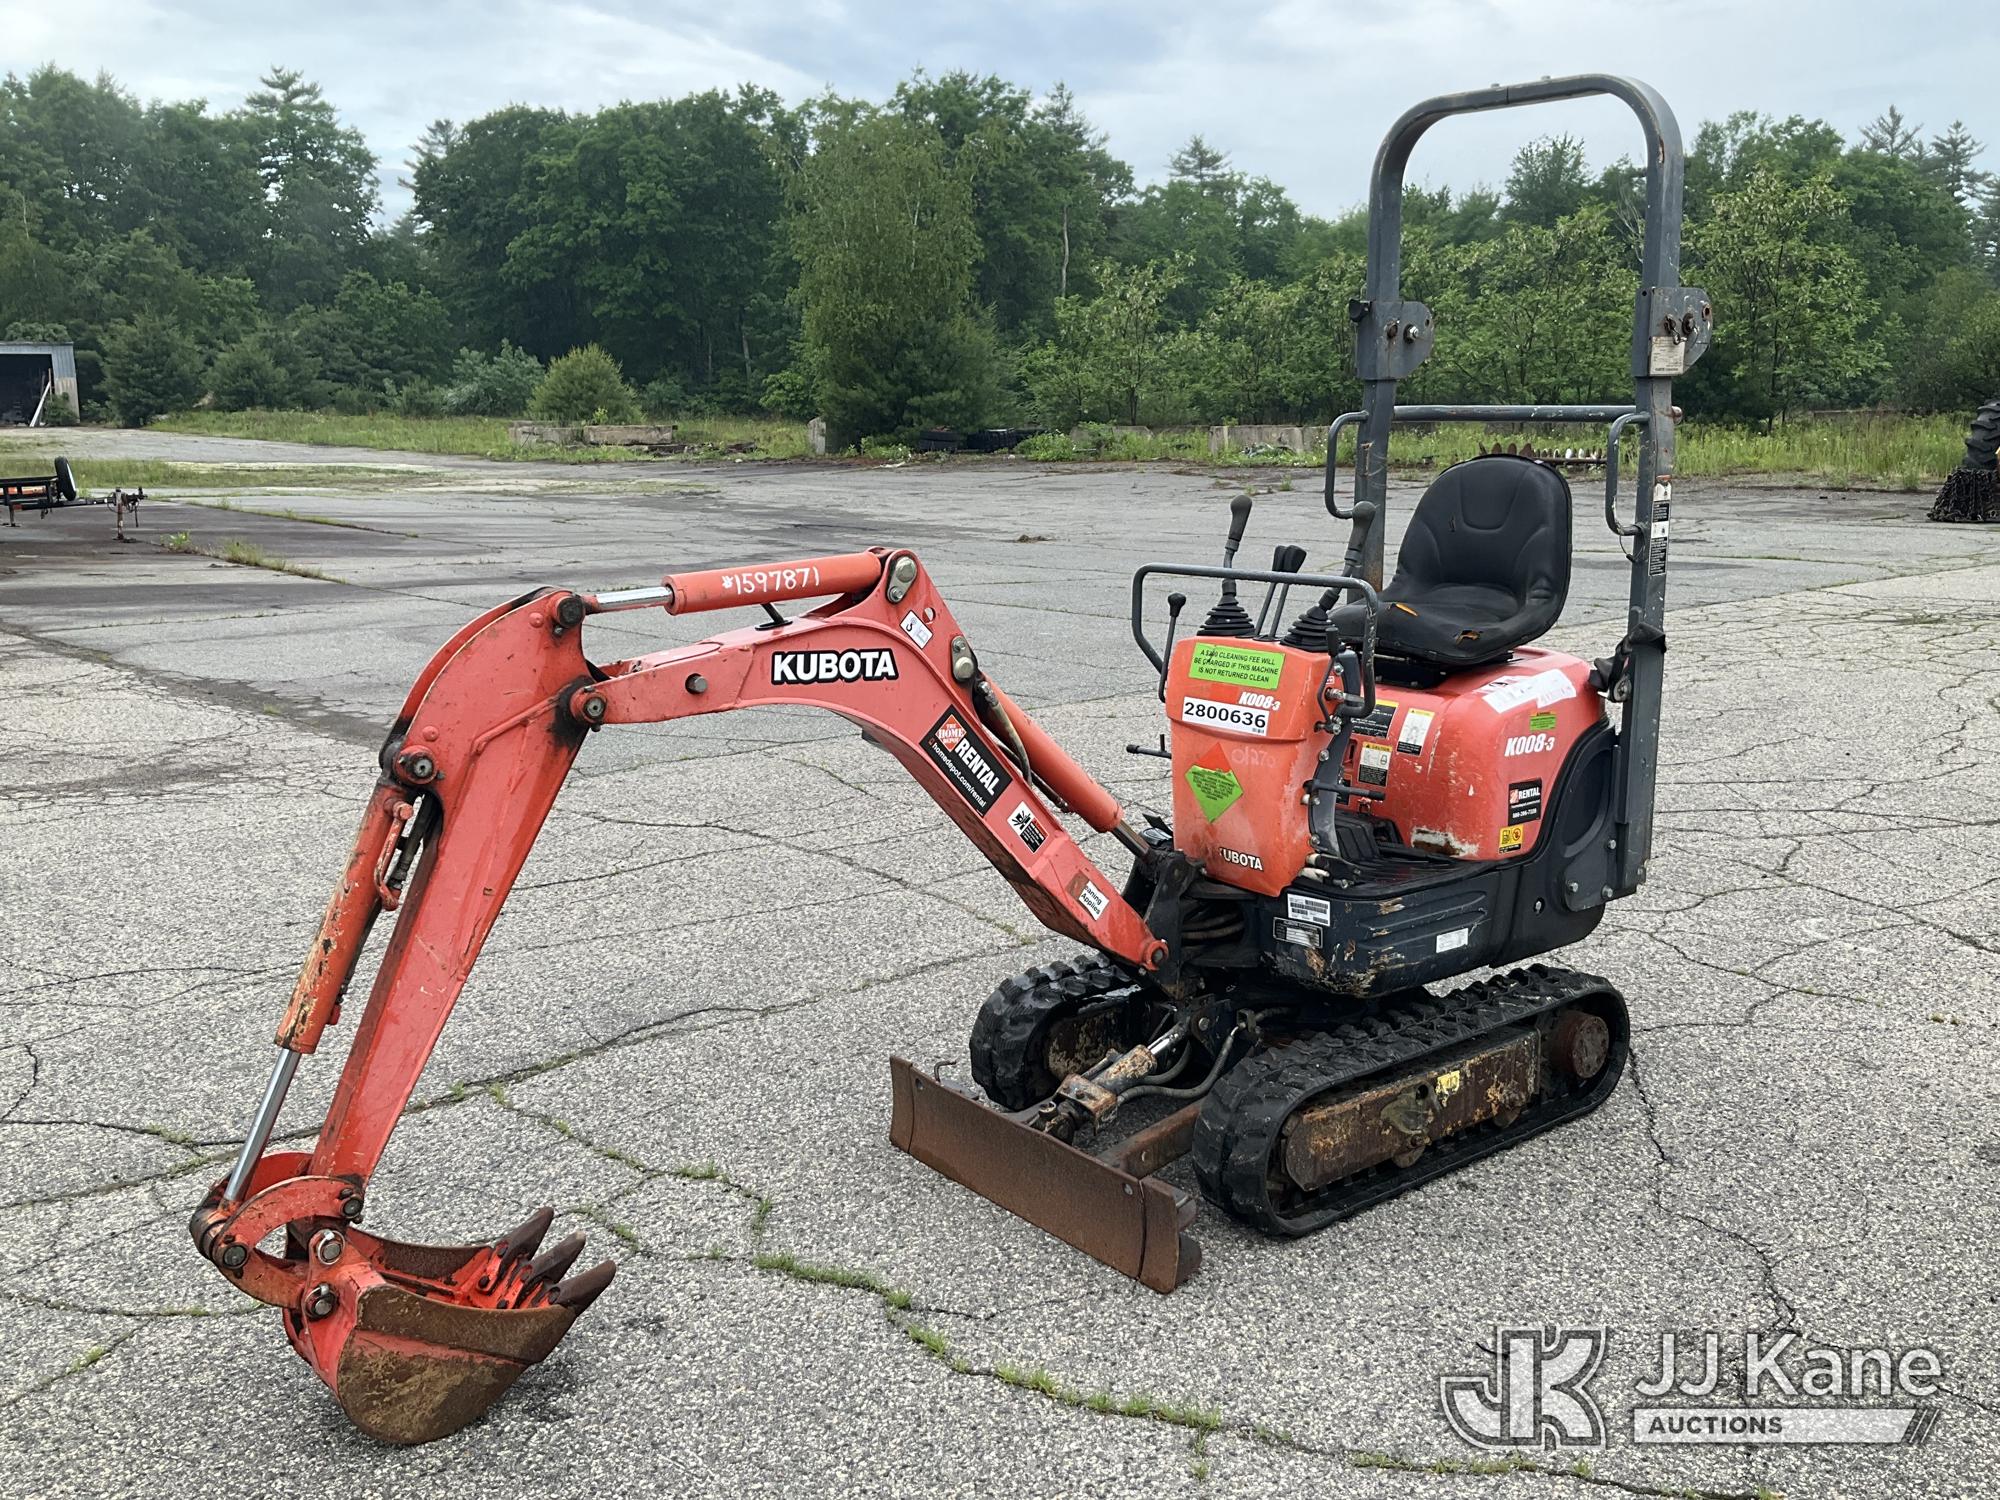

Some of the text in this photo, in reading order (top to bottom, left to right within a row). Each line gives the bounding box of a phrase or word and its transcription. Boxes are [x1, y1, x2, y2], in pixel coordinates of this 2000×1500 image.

[773, 651, 896, 682] KUBOTA
[1203, 659, 1230, 668] CHARGED
[1238, 663, 1250, 671] THIS
[1251, 665, 1278, 675] MACHINE
[1219, 651, 1248, 661] CLEANING
[1261, 657, 1275, 666] WILL
[1205, 667, 1216, 675] NOT
[1217, 669, 1248, 680] RETURNED
[1249, 674, 1269, 682] CLEAN
[1238, 691, 1280, 711] K008-3
[1184, 702, 1266, 728] 2800636
[938, 728, 963, 738] HOME
[1504, 733, 1555, 757] K008-3
[931, 742, 987, 808] homedepot.com/rental
[955, 738, 1000, 796] RENTAL
[1518, 787, 1540, 800] RENTAL
[1219, 847, 1263, 871] UBOTA
[1081, 893, 1101, 915] Applies
